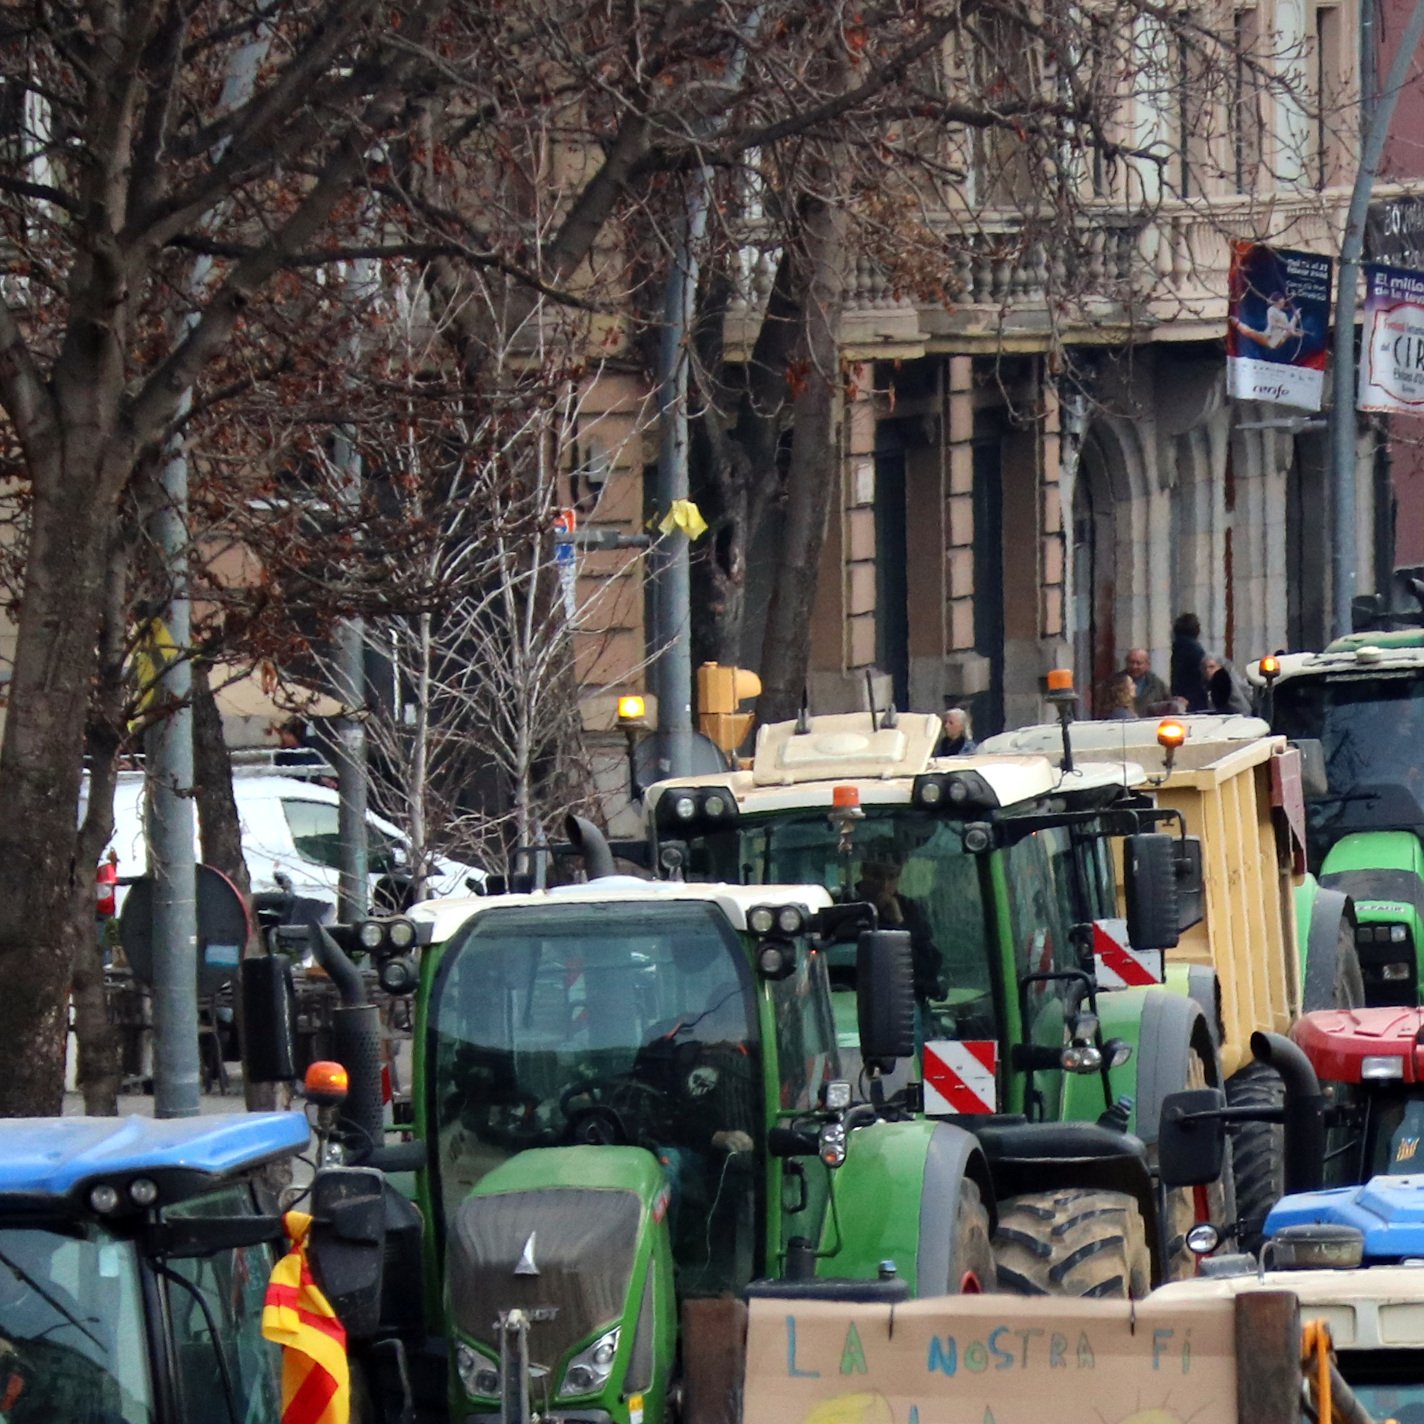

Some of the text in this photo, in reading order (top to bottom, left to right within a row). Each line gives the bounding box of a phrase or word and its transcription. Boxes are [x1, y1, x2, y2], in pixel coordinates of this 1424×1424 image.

[1375, 272, 1388, 286] El
[786, 1315, 869, 1378] LA
[928, 1325, 1095, 1377] NOSTRA
